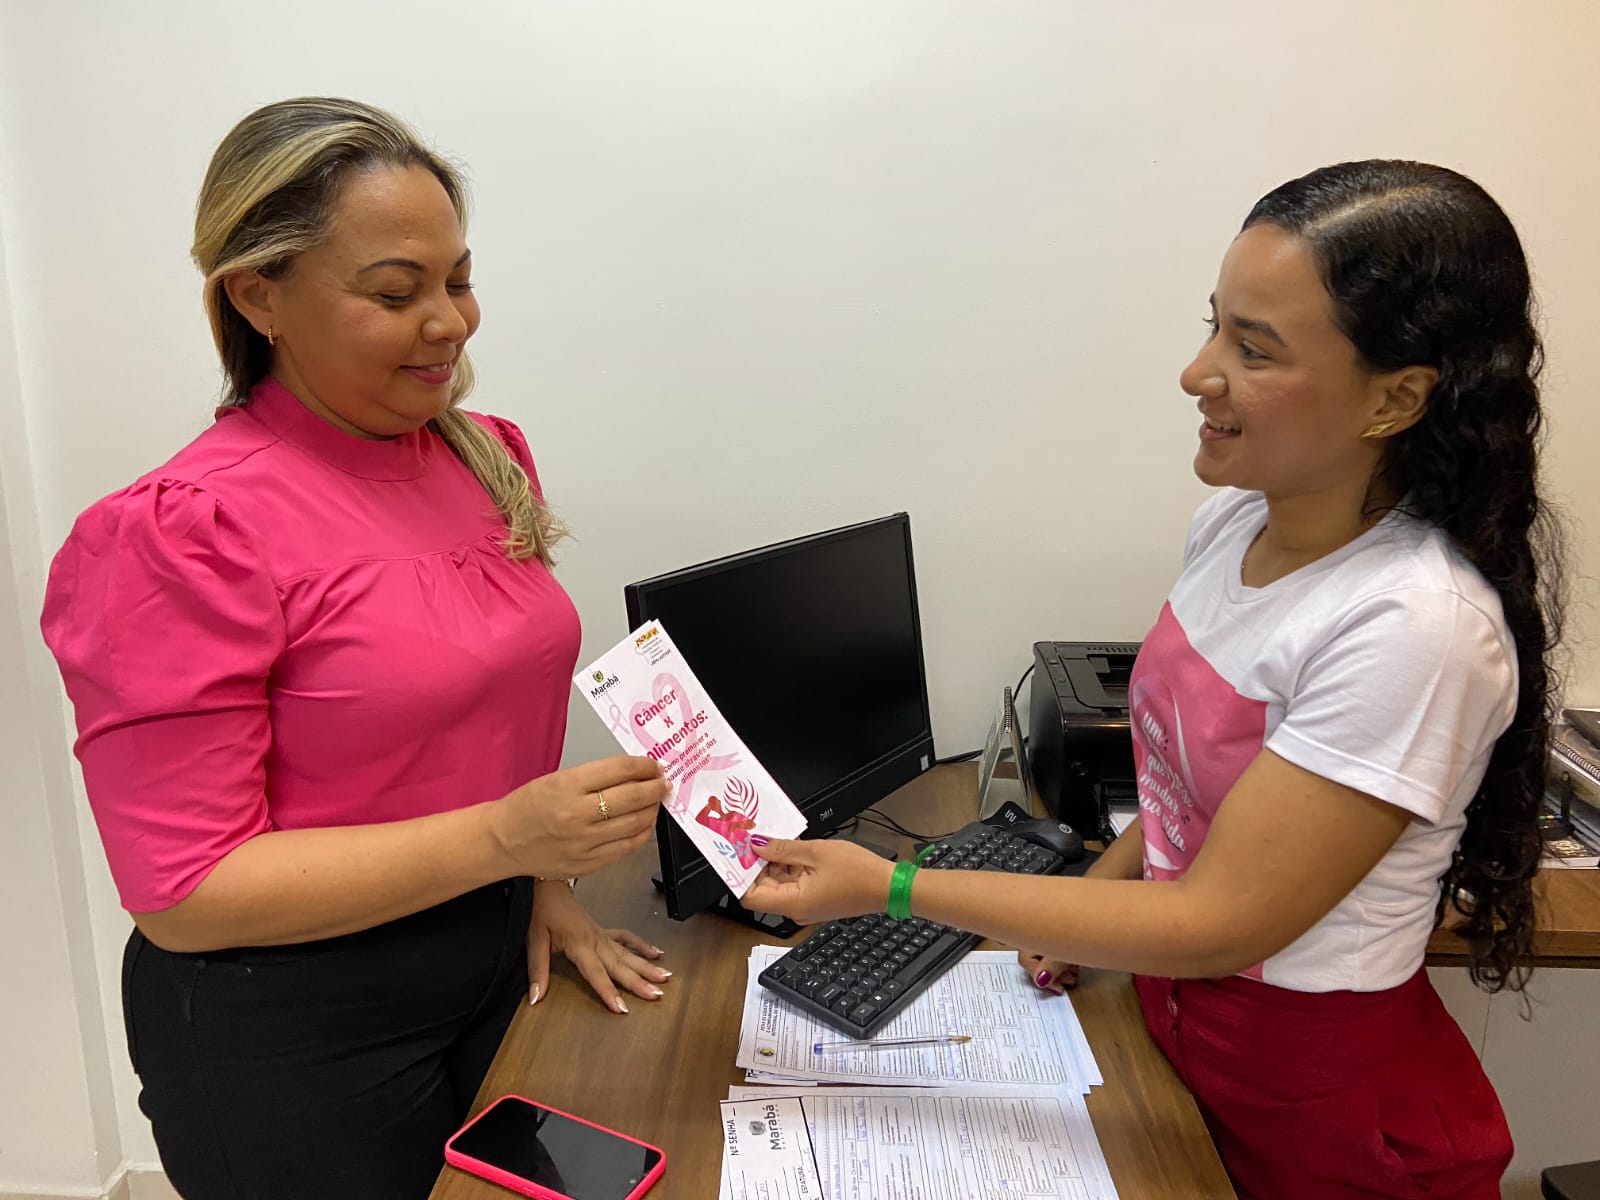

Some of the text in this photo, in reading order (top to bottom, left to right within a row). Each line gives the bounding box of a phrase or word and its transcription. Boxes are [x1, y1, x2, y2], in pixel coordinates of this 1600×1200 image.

[591, 674, 619, 698] Marabá
[634, 689, 677, 727] Câncer
[1138, 790, 1162, 817] ua
[726, 1119, 738, 1144] SENHA
[762, 1104, 782, 1150] Marabá
[798, 1166, 809, 1194] ESTATURA
